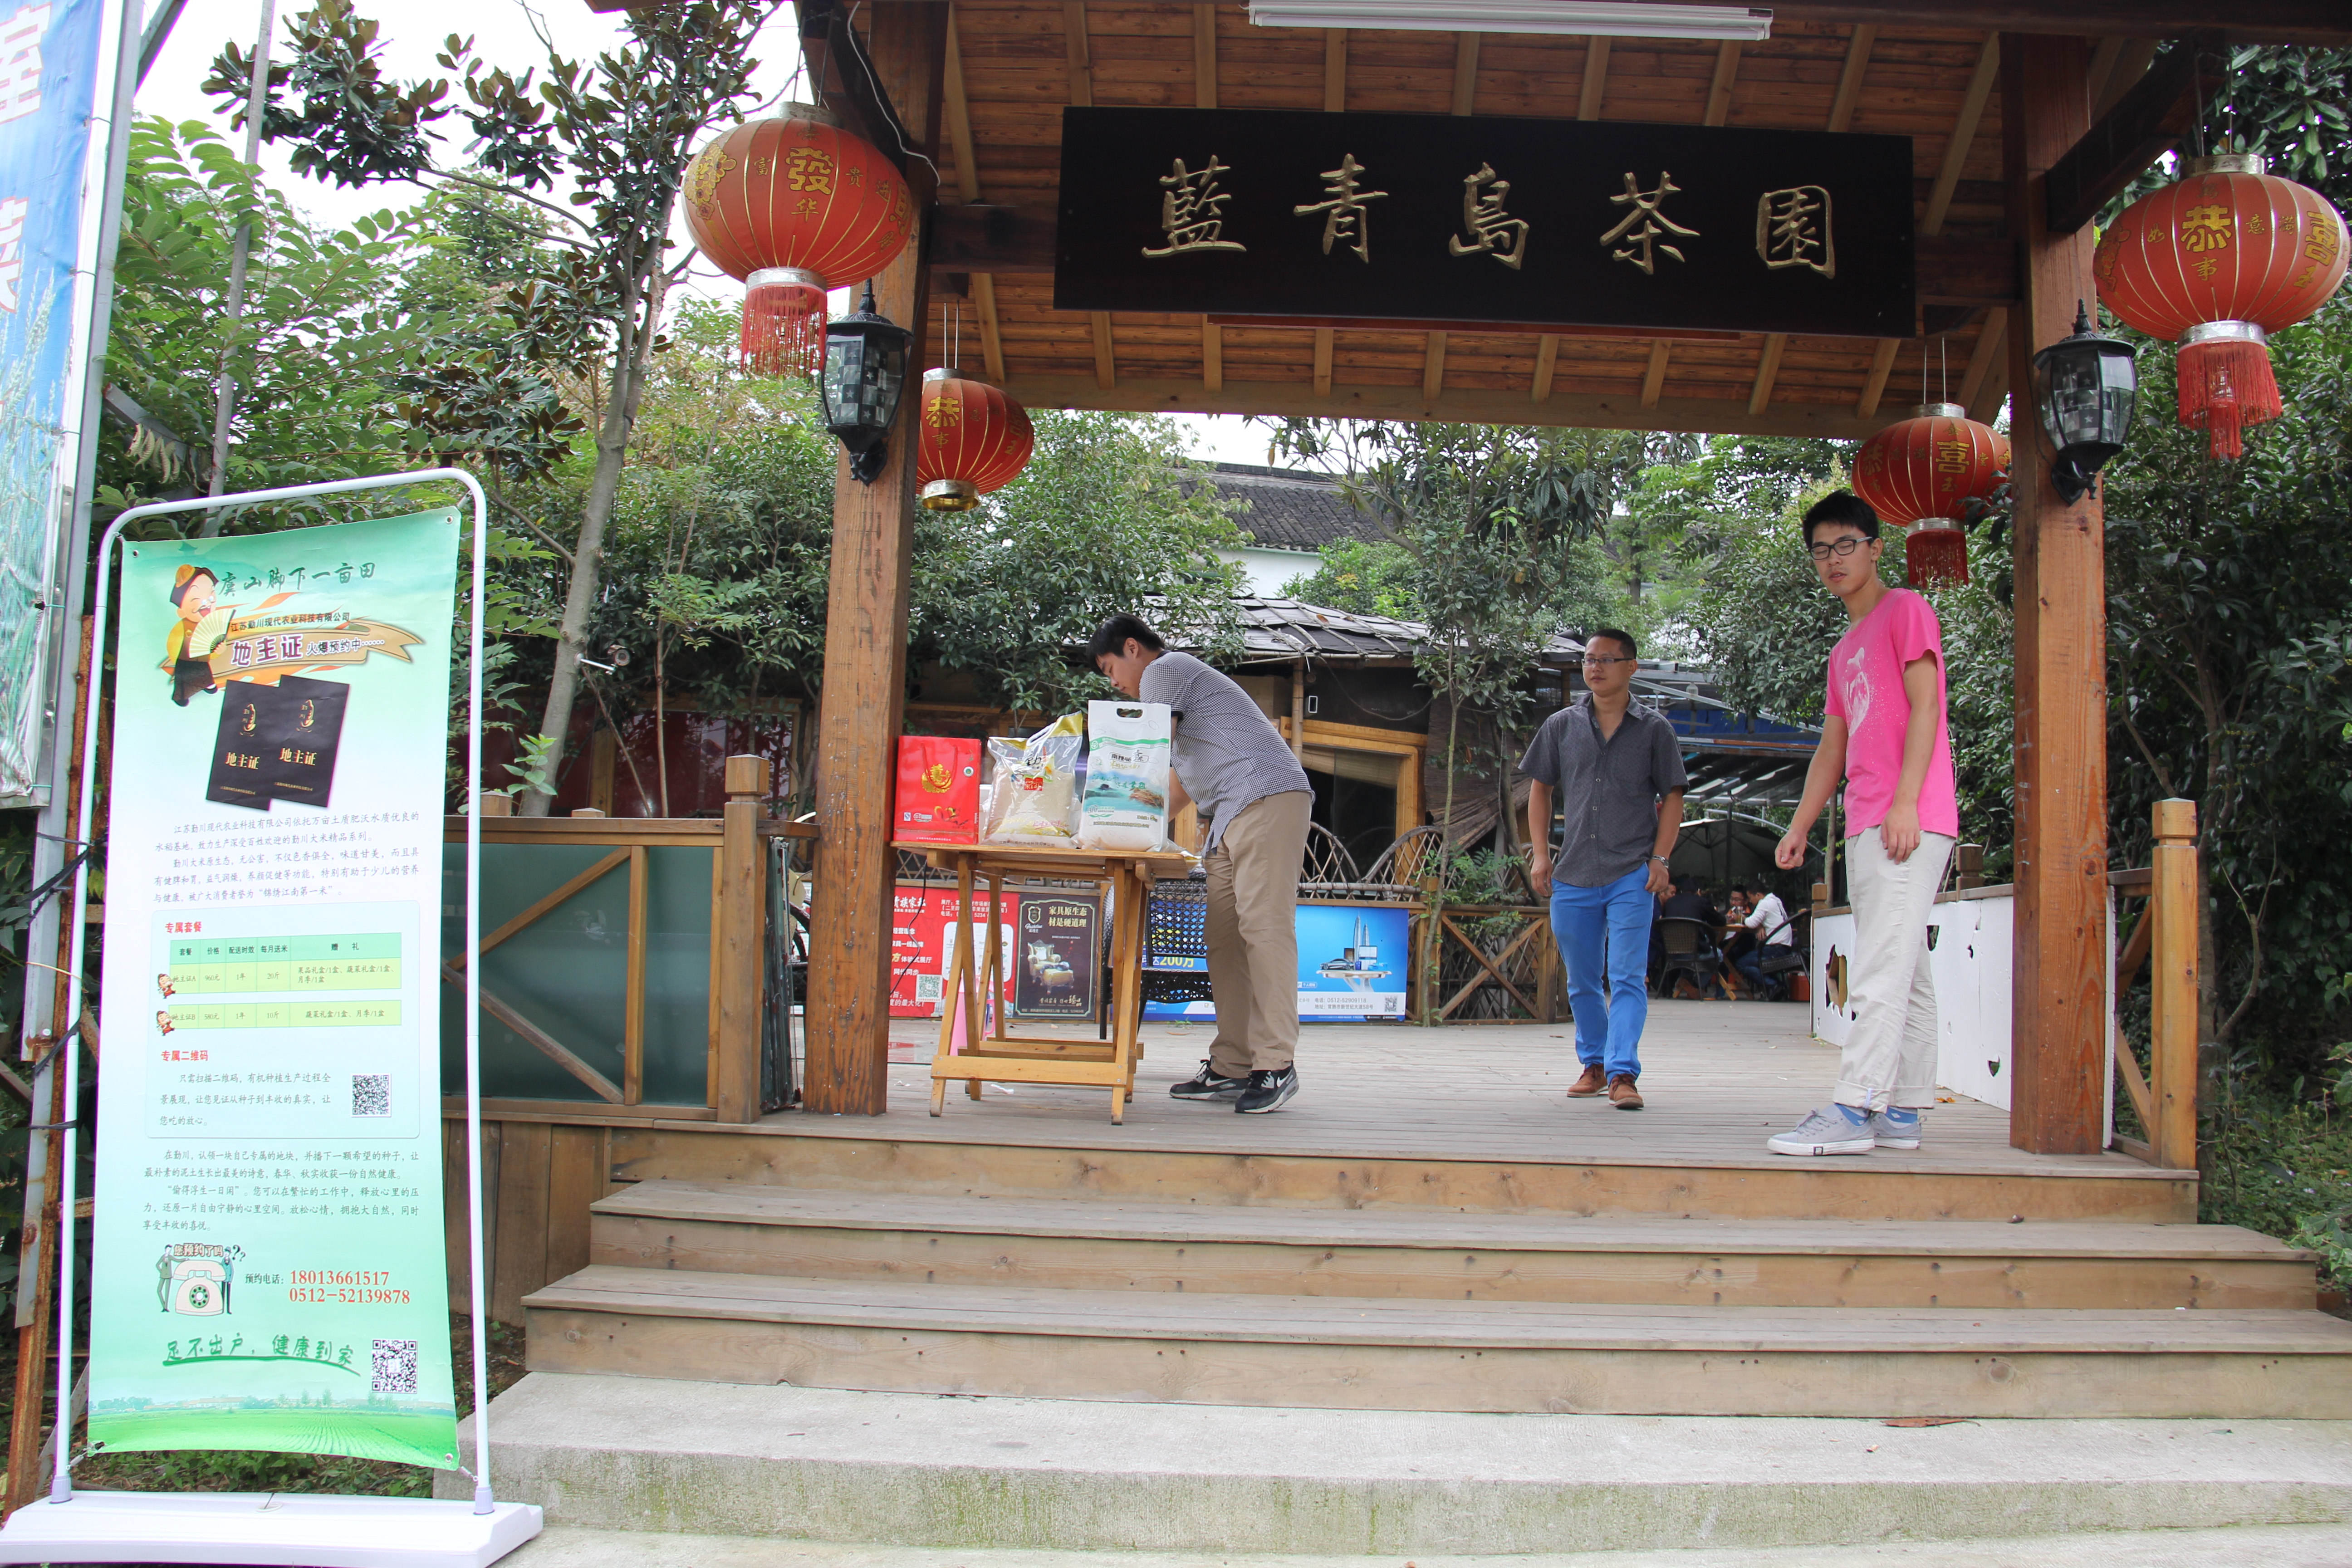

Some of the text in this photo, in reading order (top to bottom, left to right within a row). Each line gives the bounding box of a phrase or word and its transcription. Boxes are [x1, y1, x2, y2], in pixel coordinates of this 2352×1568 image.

[754, 157, 771, 176] 富
[785, 147, 834, 195] 發
[845, 166, 863, 187] 贵
[791, 198, 819, 222] 华
[2180, 203, 2232, 252] 恭
[2246, 214, 2265, 235] 意
[2304, 211, 2341, 266] 喜
[2191, 256, 2218, 281] 事
[926, 396, 960, 427] 恭
[1943, 424, 1964, 436] 金
[932, 431, 949, 448] 事
[1936, 441, 1970, 474] 喜
[1978, 452, 1989, 466] 堂
[1941, 477, 1957, 491] 玉
[219, 562, 376, 597] 虞山脚下一亩田
[230, 612, 350, 632] 江苏勤川现代农业科技有限公司
[231, 634, 303, 666] 地主证
[225, 752, 260, 769] 地主证
[279, 748, 317, 766] 地主证
[174, 811, 419, 834] 江苏勤川现代农业科技有限公司依托万亩土质肥沃水质优良的
[1049, 906, 1088, 916] 家具原生态
[165, 921, 202, 933] 专属套餐
[1048, 917, 1087, 927] 材是硬道理
[179, 948, 192, 956] 套餐
[207, 947, 220, 955] 价格
[229, 946, 255, 954] 配送时效
[260, 945, 288, 953] 每月送米
[161, 1050, 209, 1062] 专属二维码
[179, 1073, 331, 1083] 只需扫描二维码，有机种植生产过程全
[160, 1094, 331, 1105] 景展现，让您见证从种子到丰收的真实，让
[159, 1115, 208, 1127] 您吃的放心。
[143, 1220, 211, 1231] 享受丰收的喜悦。
[174, 1243, 224, 1257] 您预约了吗
[290, 1270, 389, 1285] 18013661517
[289, 1288, 410, 1304] 0512-52139878
